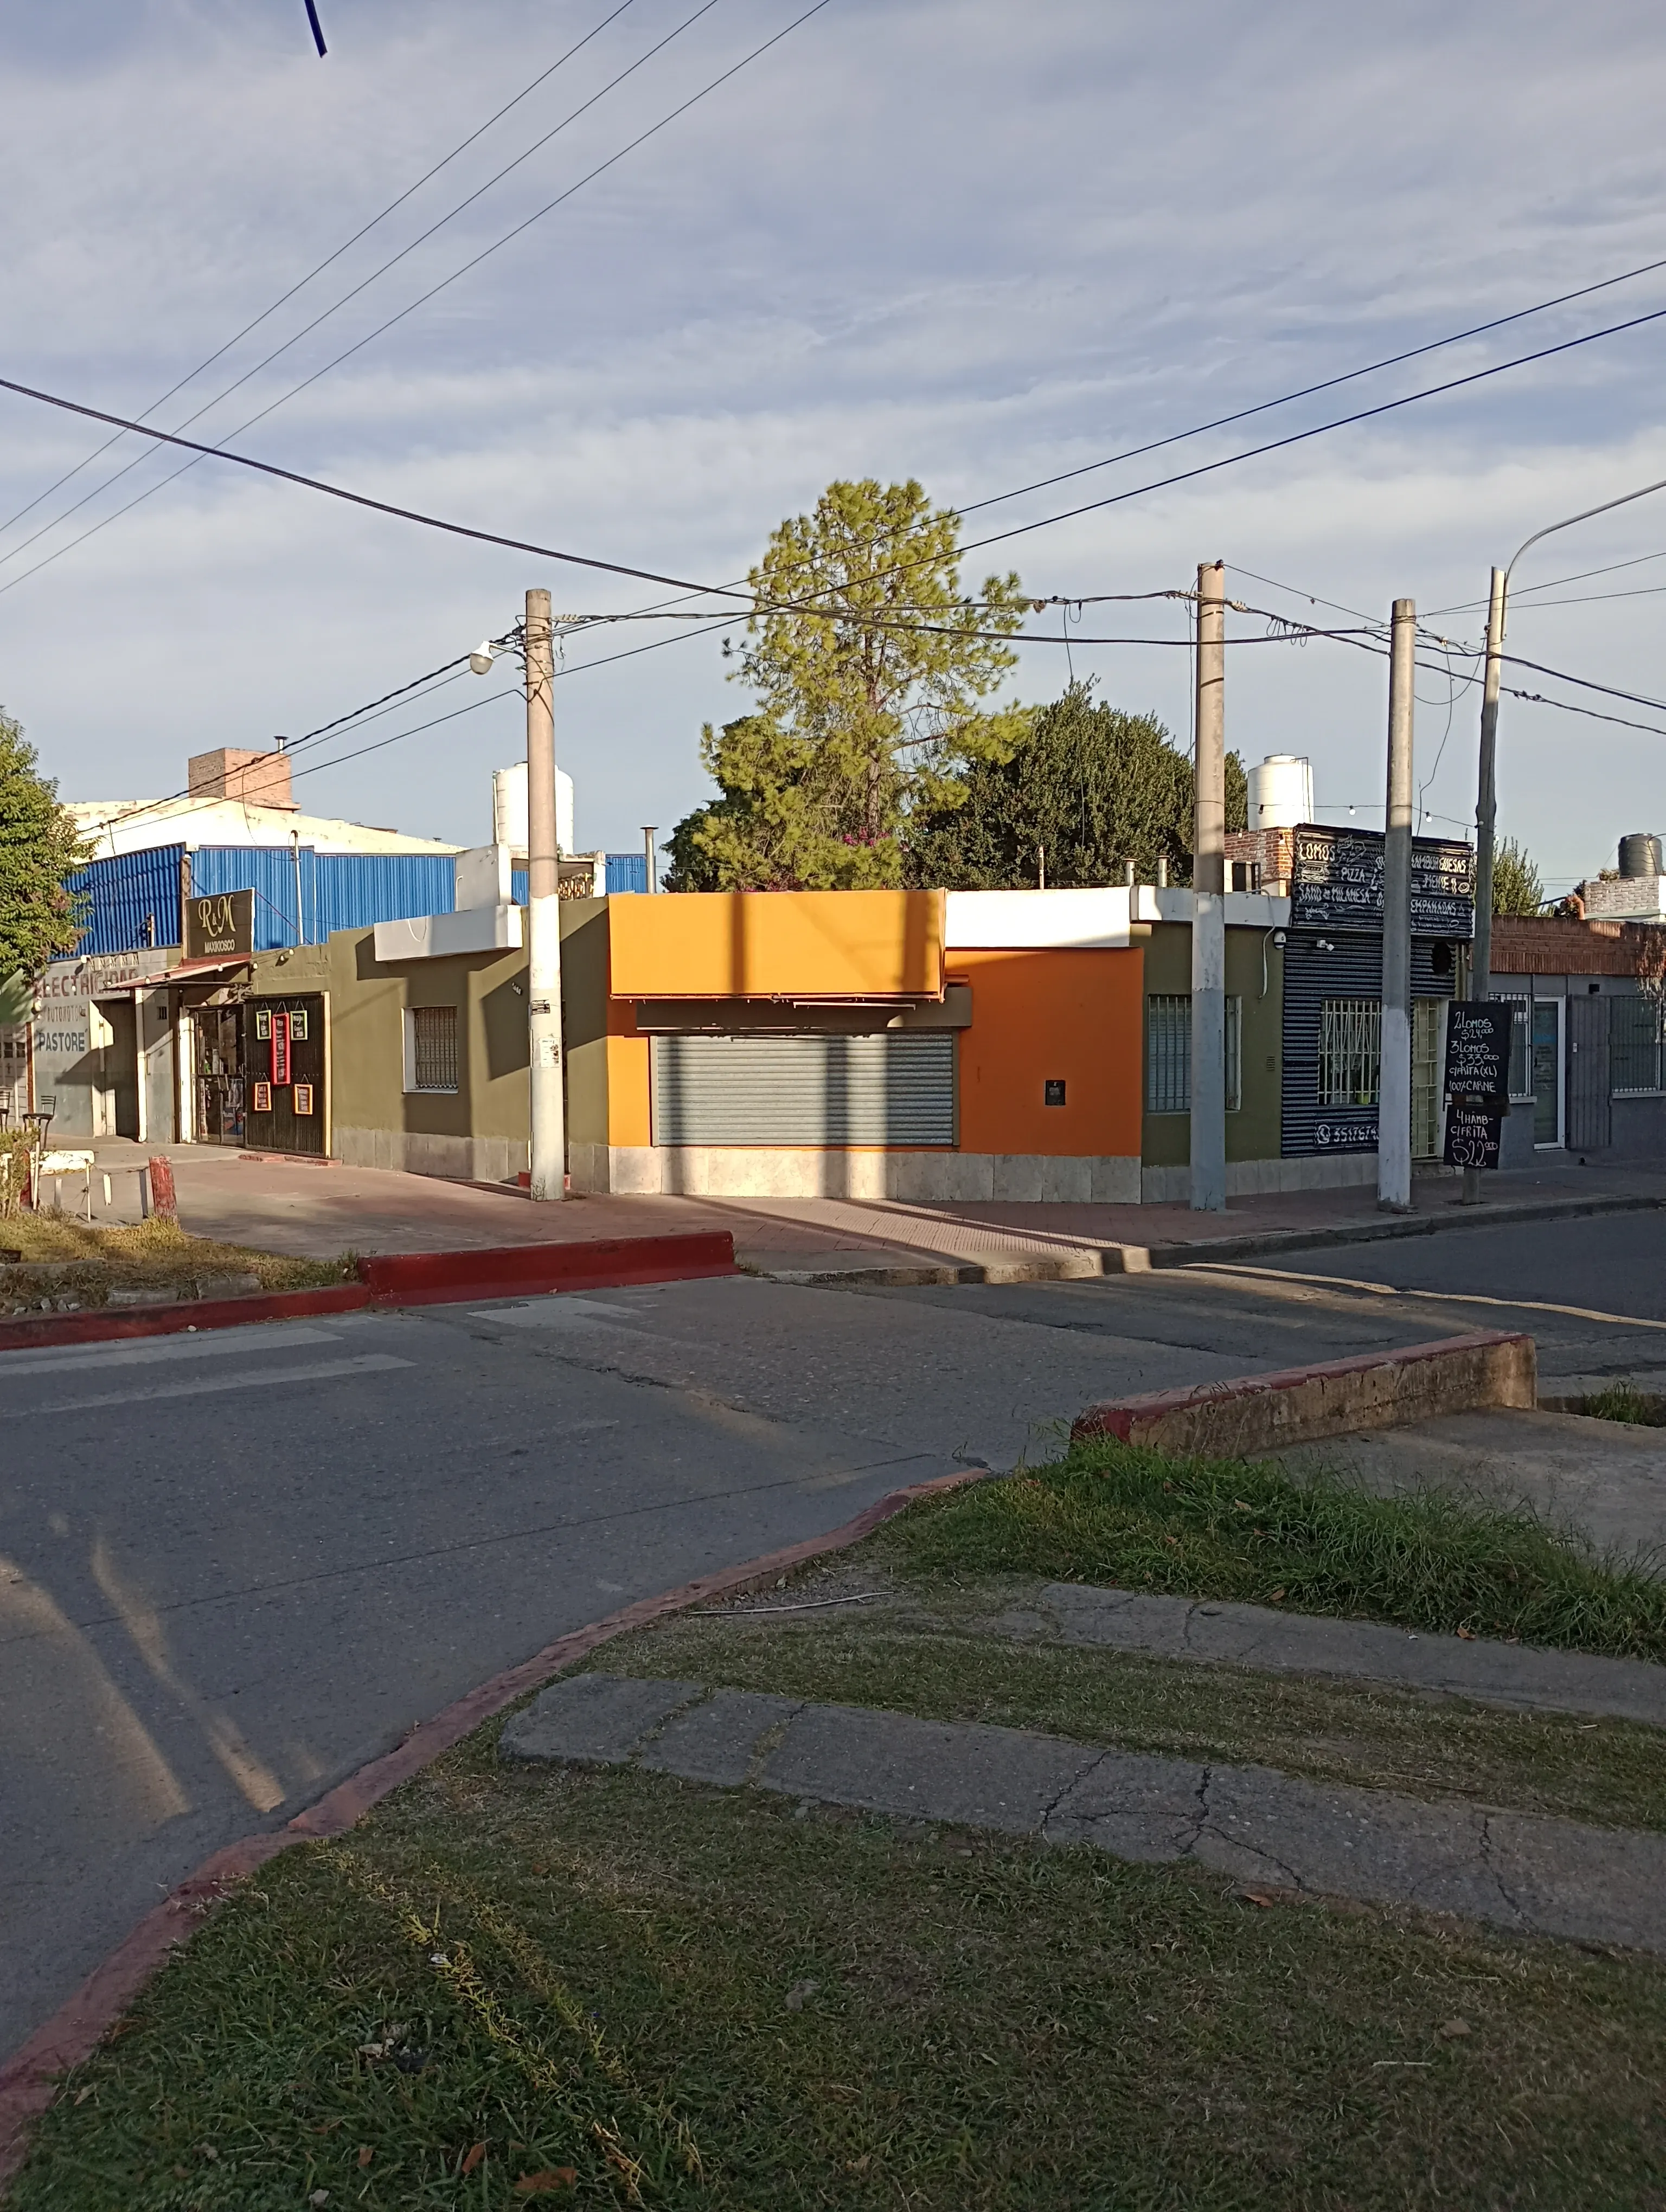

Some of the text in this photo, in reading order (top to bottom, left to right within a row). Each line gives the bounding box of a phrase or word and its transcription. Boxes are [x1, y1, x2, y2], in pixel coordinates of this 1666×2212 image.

[1299, 843, 1335, 861] LOMOS
[1341, 867, 1366, 883] PIZZA
[1332, 886, 1370, 904] MILANESA
[1411, 899, 1456, 916] EMPANADAS
[204, 938, 235, 954] MAXIKIOSCO
